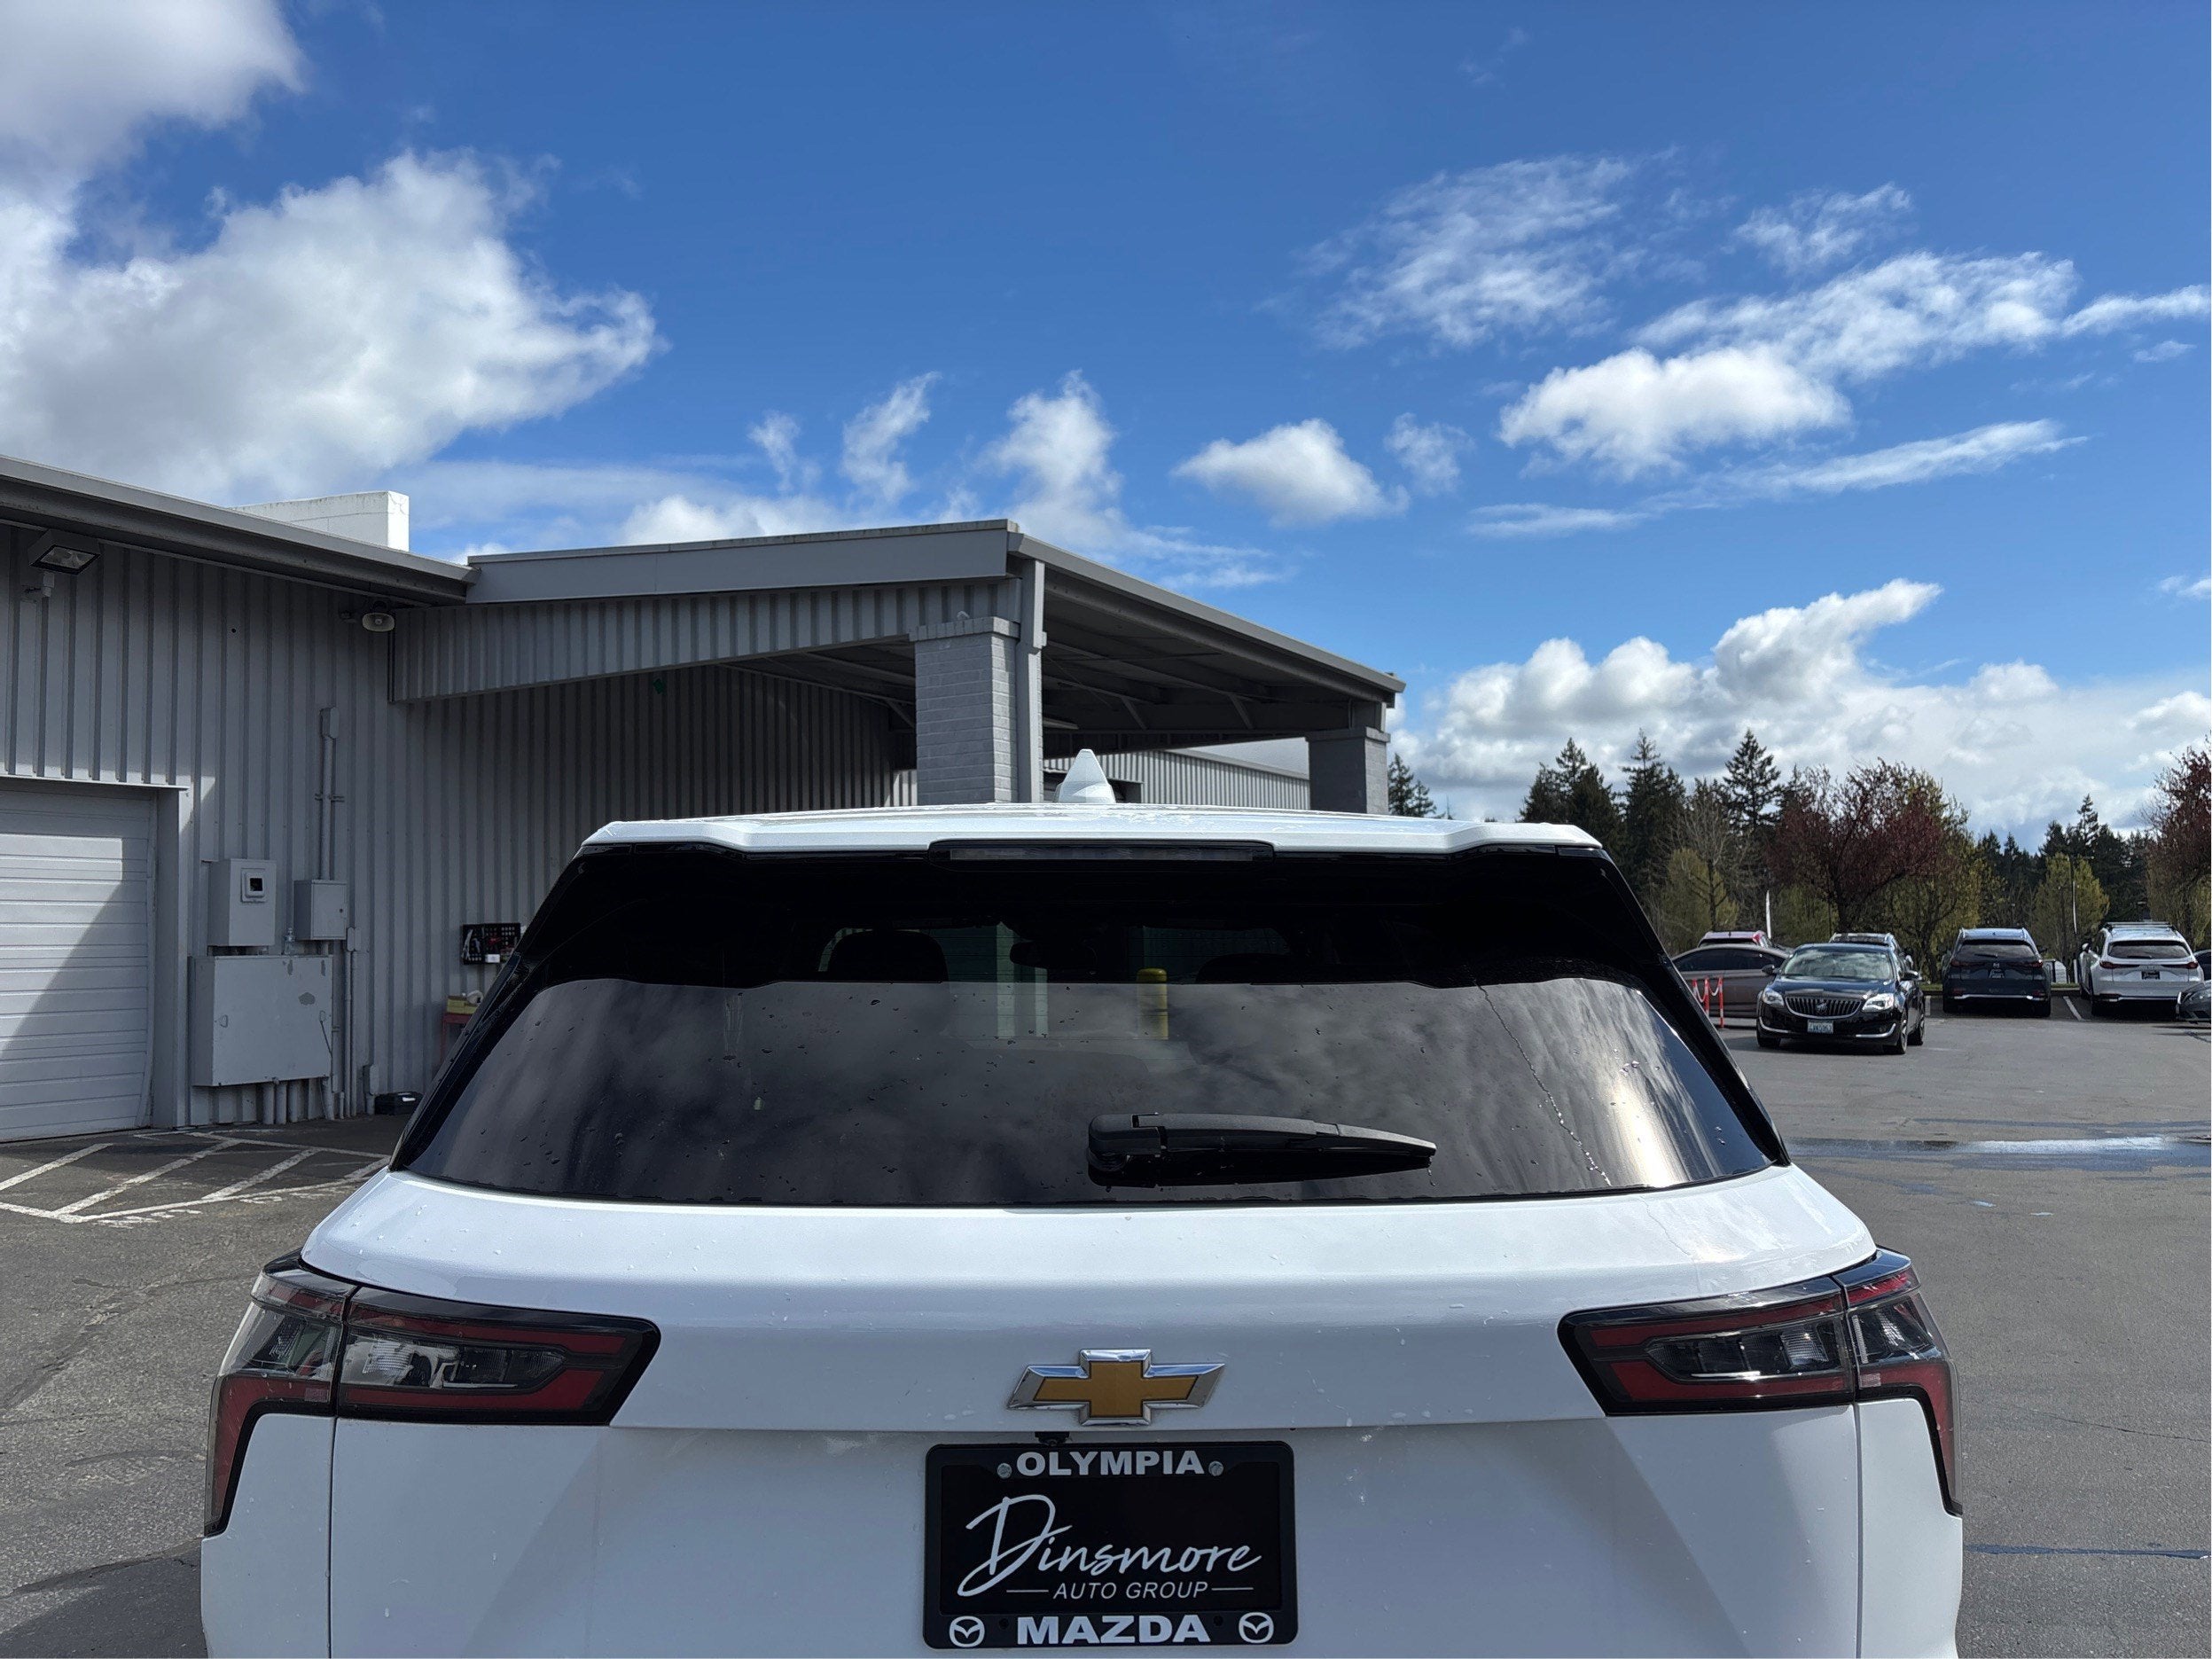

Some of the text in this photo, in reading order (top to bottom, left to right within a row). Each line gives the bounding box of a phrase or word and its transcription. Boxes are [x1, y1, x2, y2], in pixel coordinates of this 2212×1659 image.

[1016, 1450, 1205, 1476] OLYMPIA
[957, 1494, 1262, 1597] Dinsmore
[1052, 1581, 1208, 1600] AUTO GROUP
[1017, 1614, 1211, 1645] MAZDA
